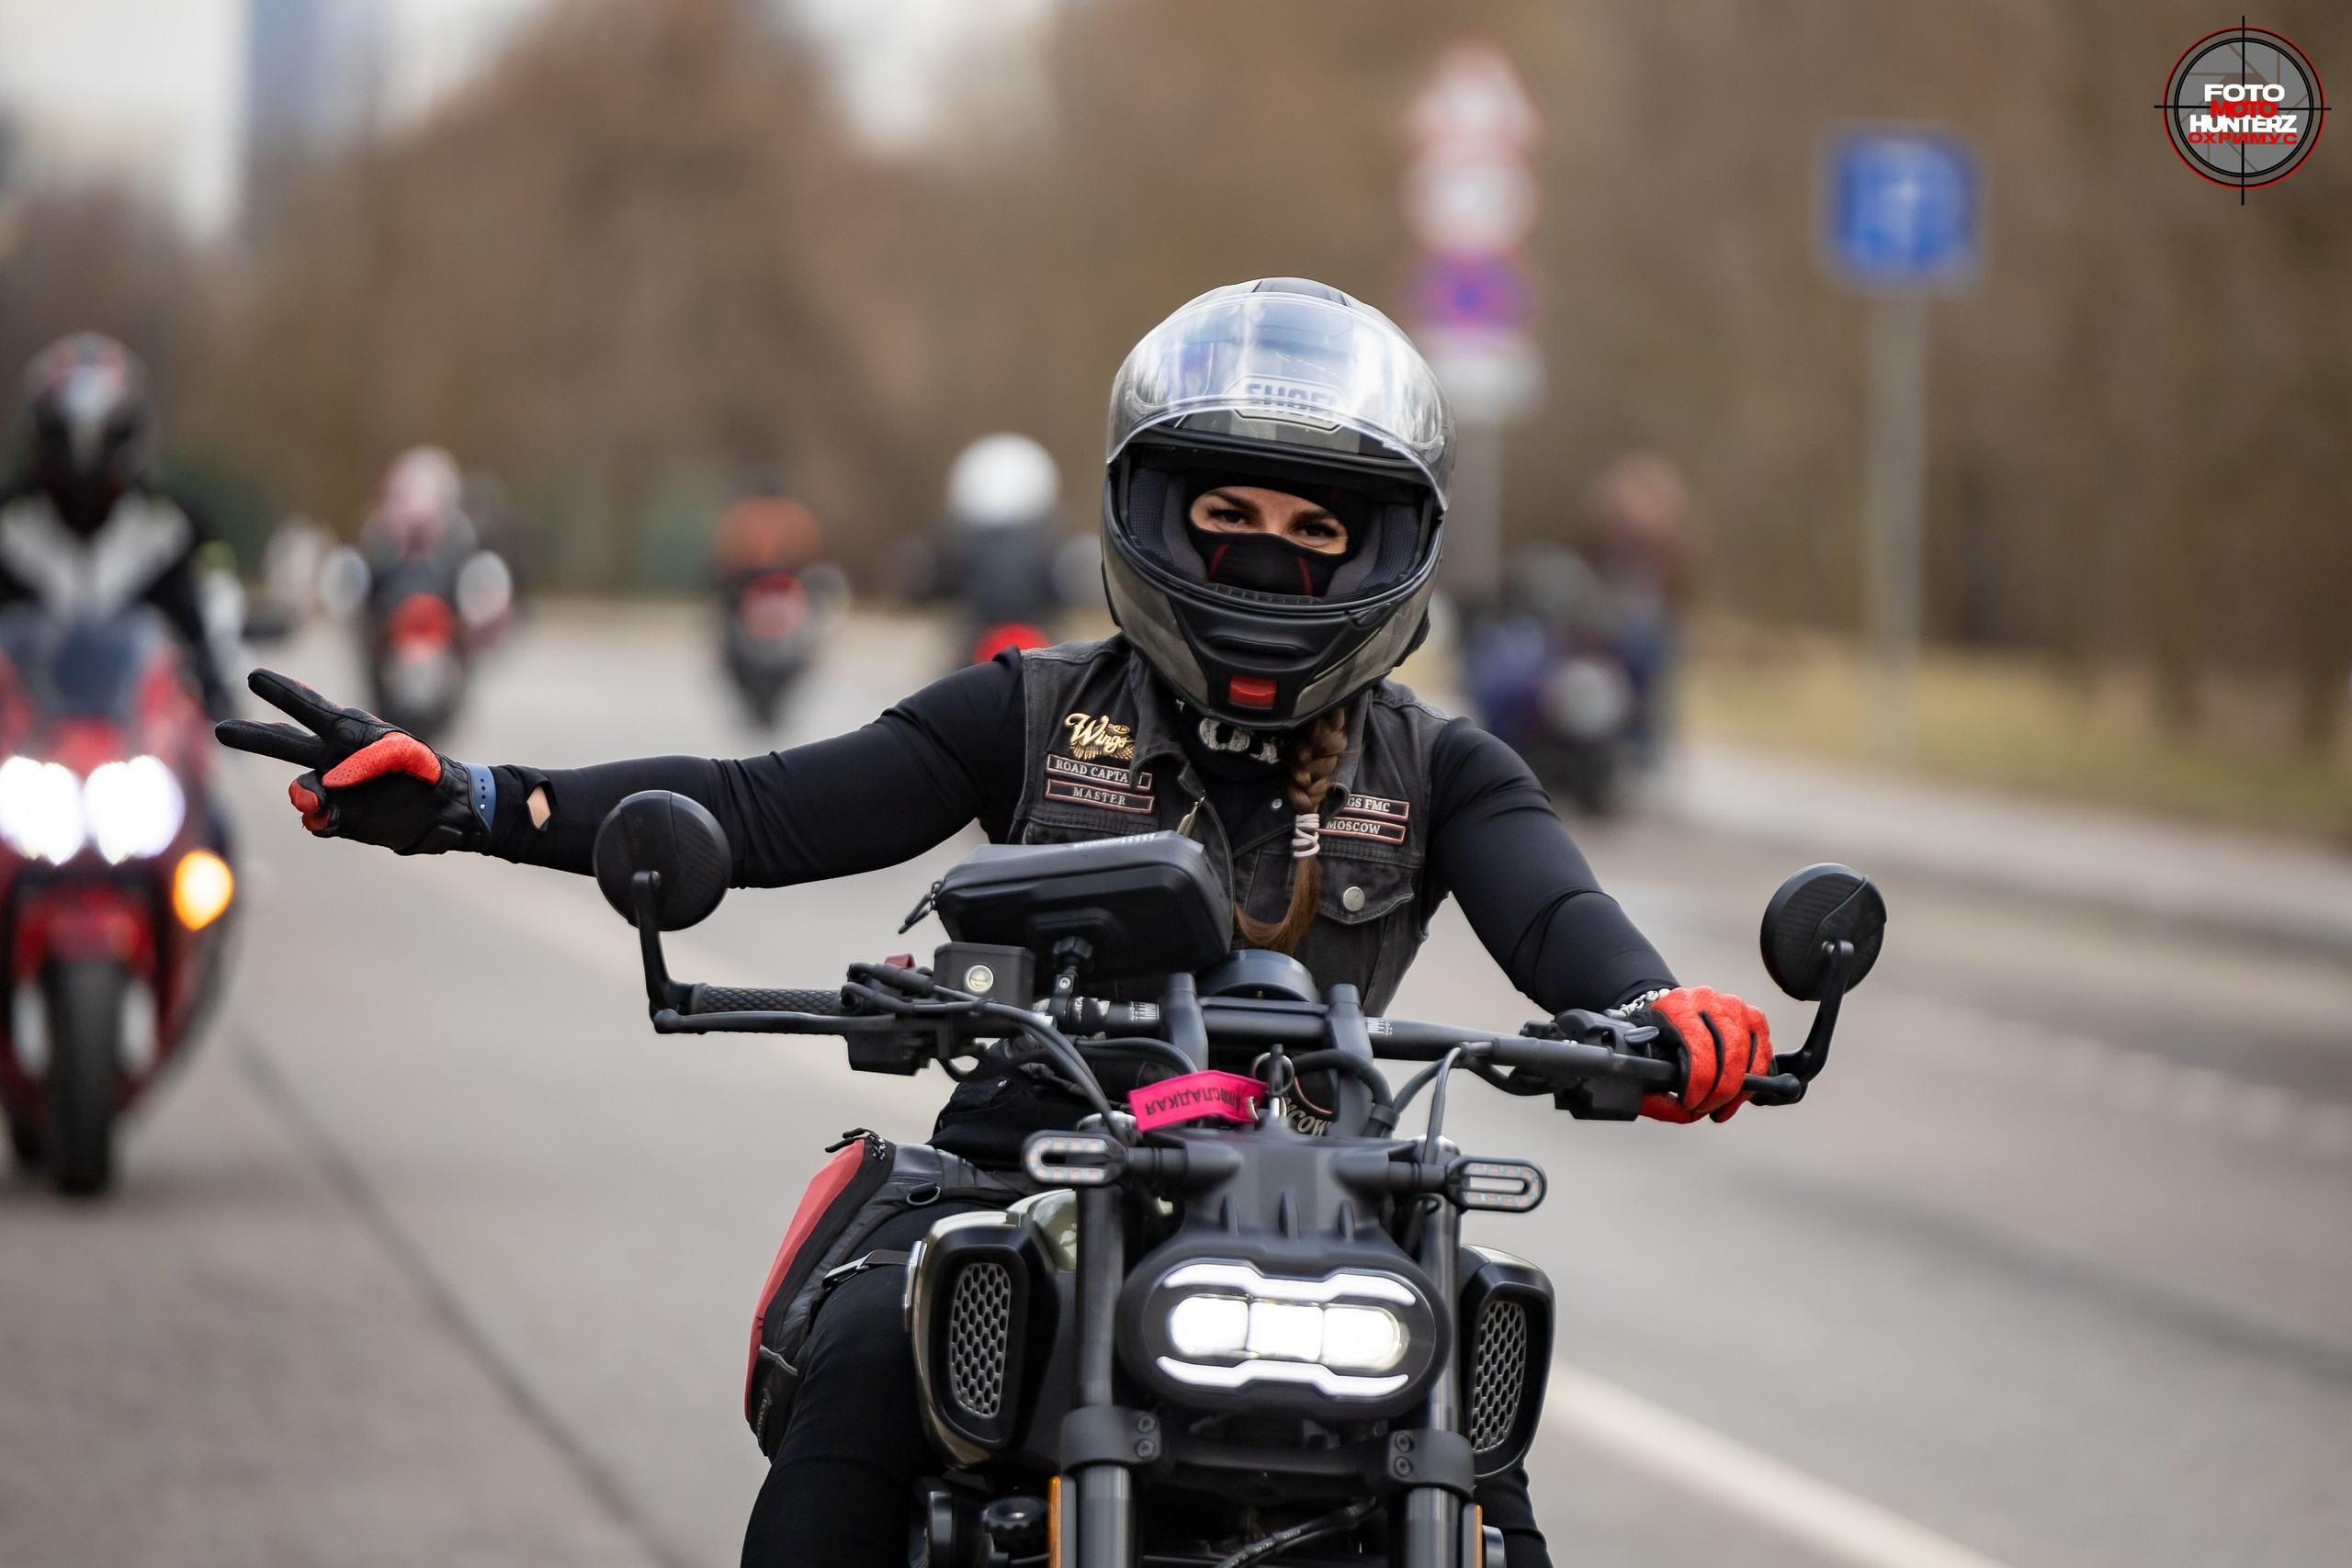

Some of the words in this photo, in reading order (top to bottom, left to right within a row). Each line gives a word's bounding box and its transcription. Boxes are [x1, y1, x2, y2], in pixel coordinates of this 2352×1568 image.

[1065, 713, 1128, 753] Wings
[1056, 759, 1088, 775] ROAD
[1091, 767, 1144, 785] CAPTA
[1072, 787, 1126, 806] MASTER
[1347, 797, 1363, 808] GS
[1364, 798, 1391, 813] FMC
[1326, 820, 1381, 835] MOSCOW
